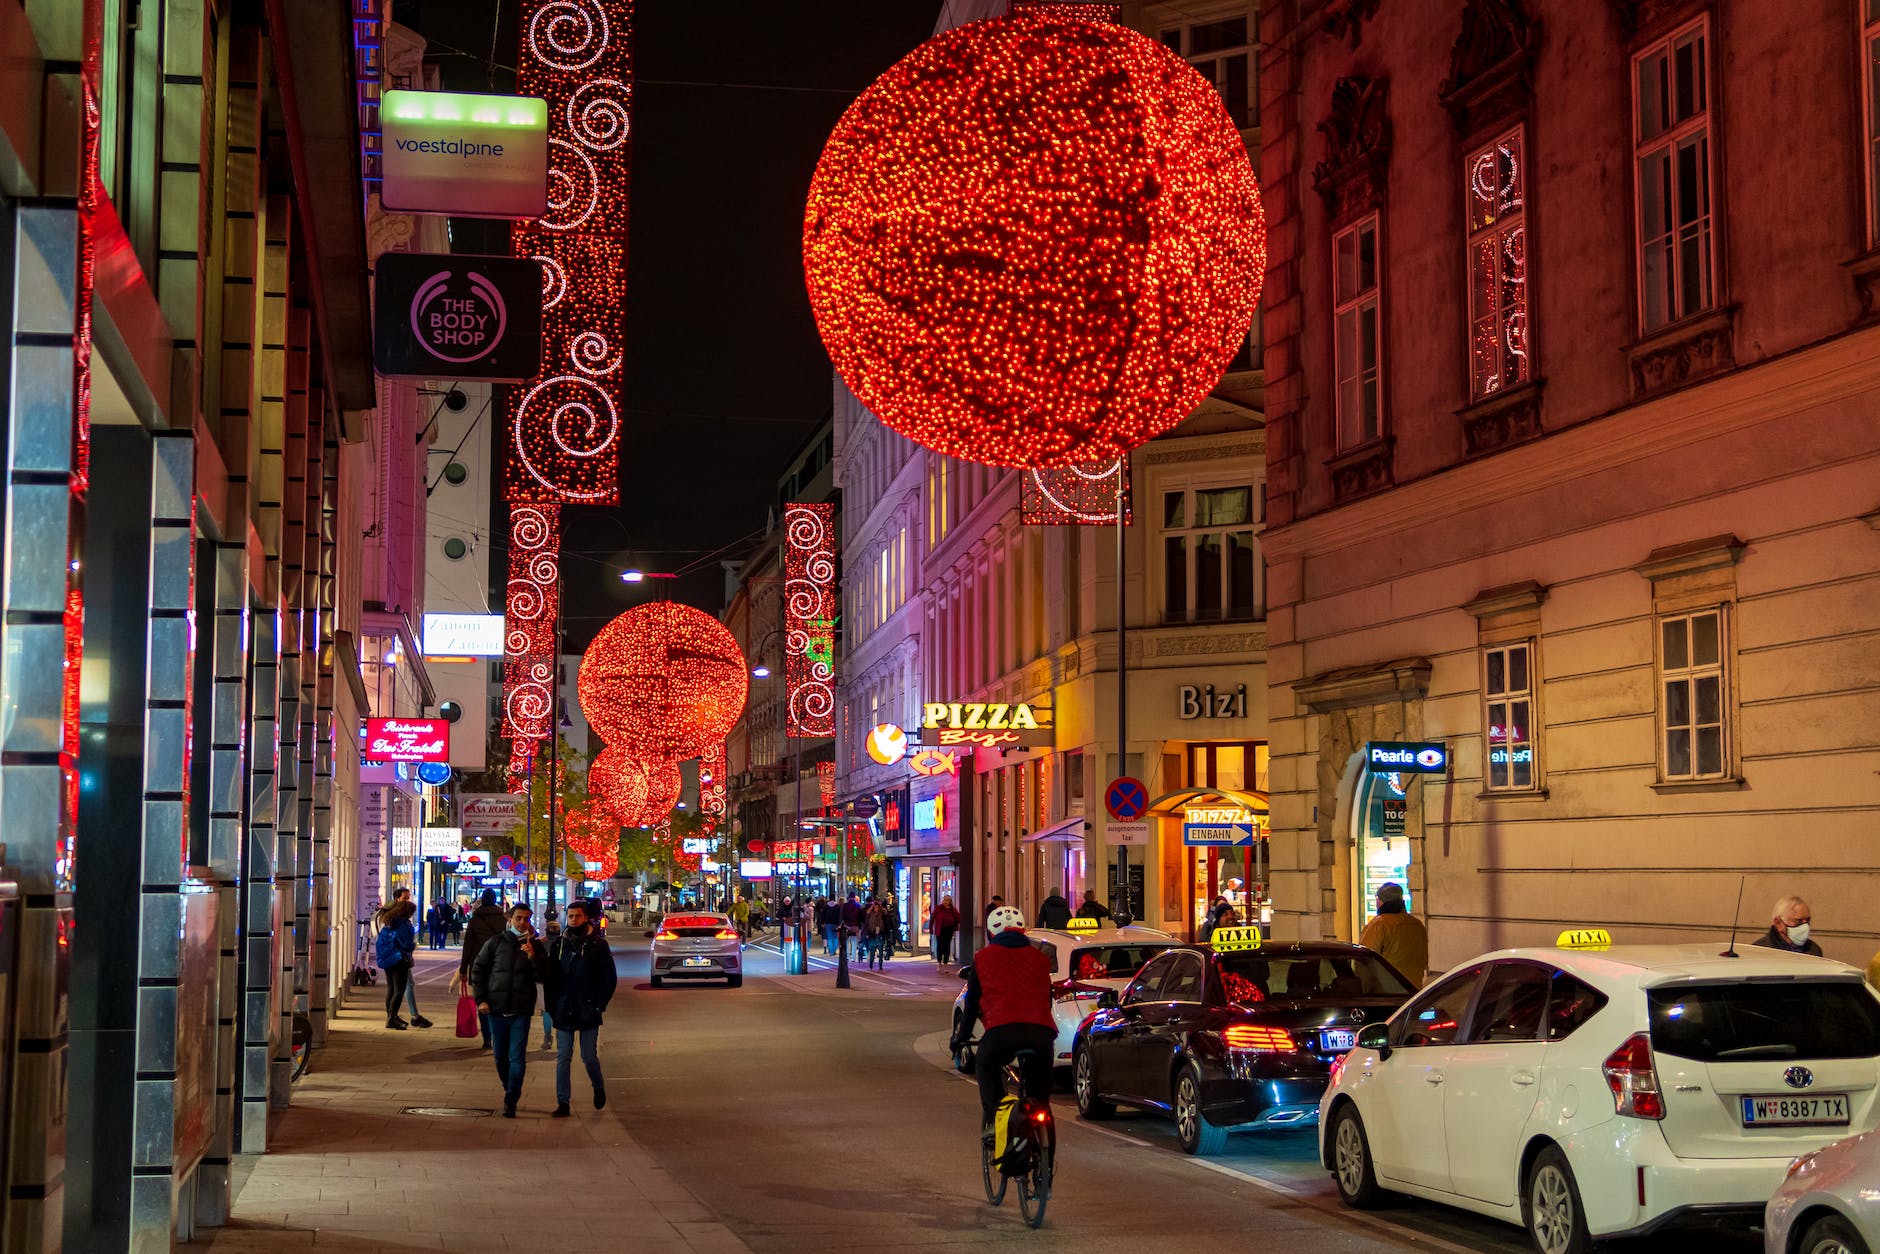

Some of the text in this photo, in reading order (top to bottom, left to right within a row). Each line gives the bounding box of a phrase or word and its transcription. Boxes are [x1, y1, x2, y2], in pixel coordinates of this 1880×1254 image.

[396, 138, 504, 158] voestalpine
[442, 298, 475, 313] THE
[430, 312, 488, 330] BODY
[432, 330, 485, 346] SHOP
[1179, 683, 1247, 720] Bizi
[923, 702, 1039, 730] PIZZA
[939, 729, 1020, 747] Bizi
[1372, 749, 1414, 763] Pearle
[1384, 811, 1397, 819] TO
[1191, 829, 1231, 840] EINBAHN
[1074, 920, 1095, 928] TAXI
[1219, 929, 1256, 942] TAXI
[1571, 931, 1608, 944] TAXI
[1329, 1035, 1338, 1047] W
[1756, 1100, 1843, 1118] W 8387 TX
